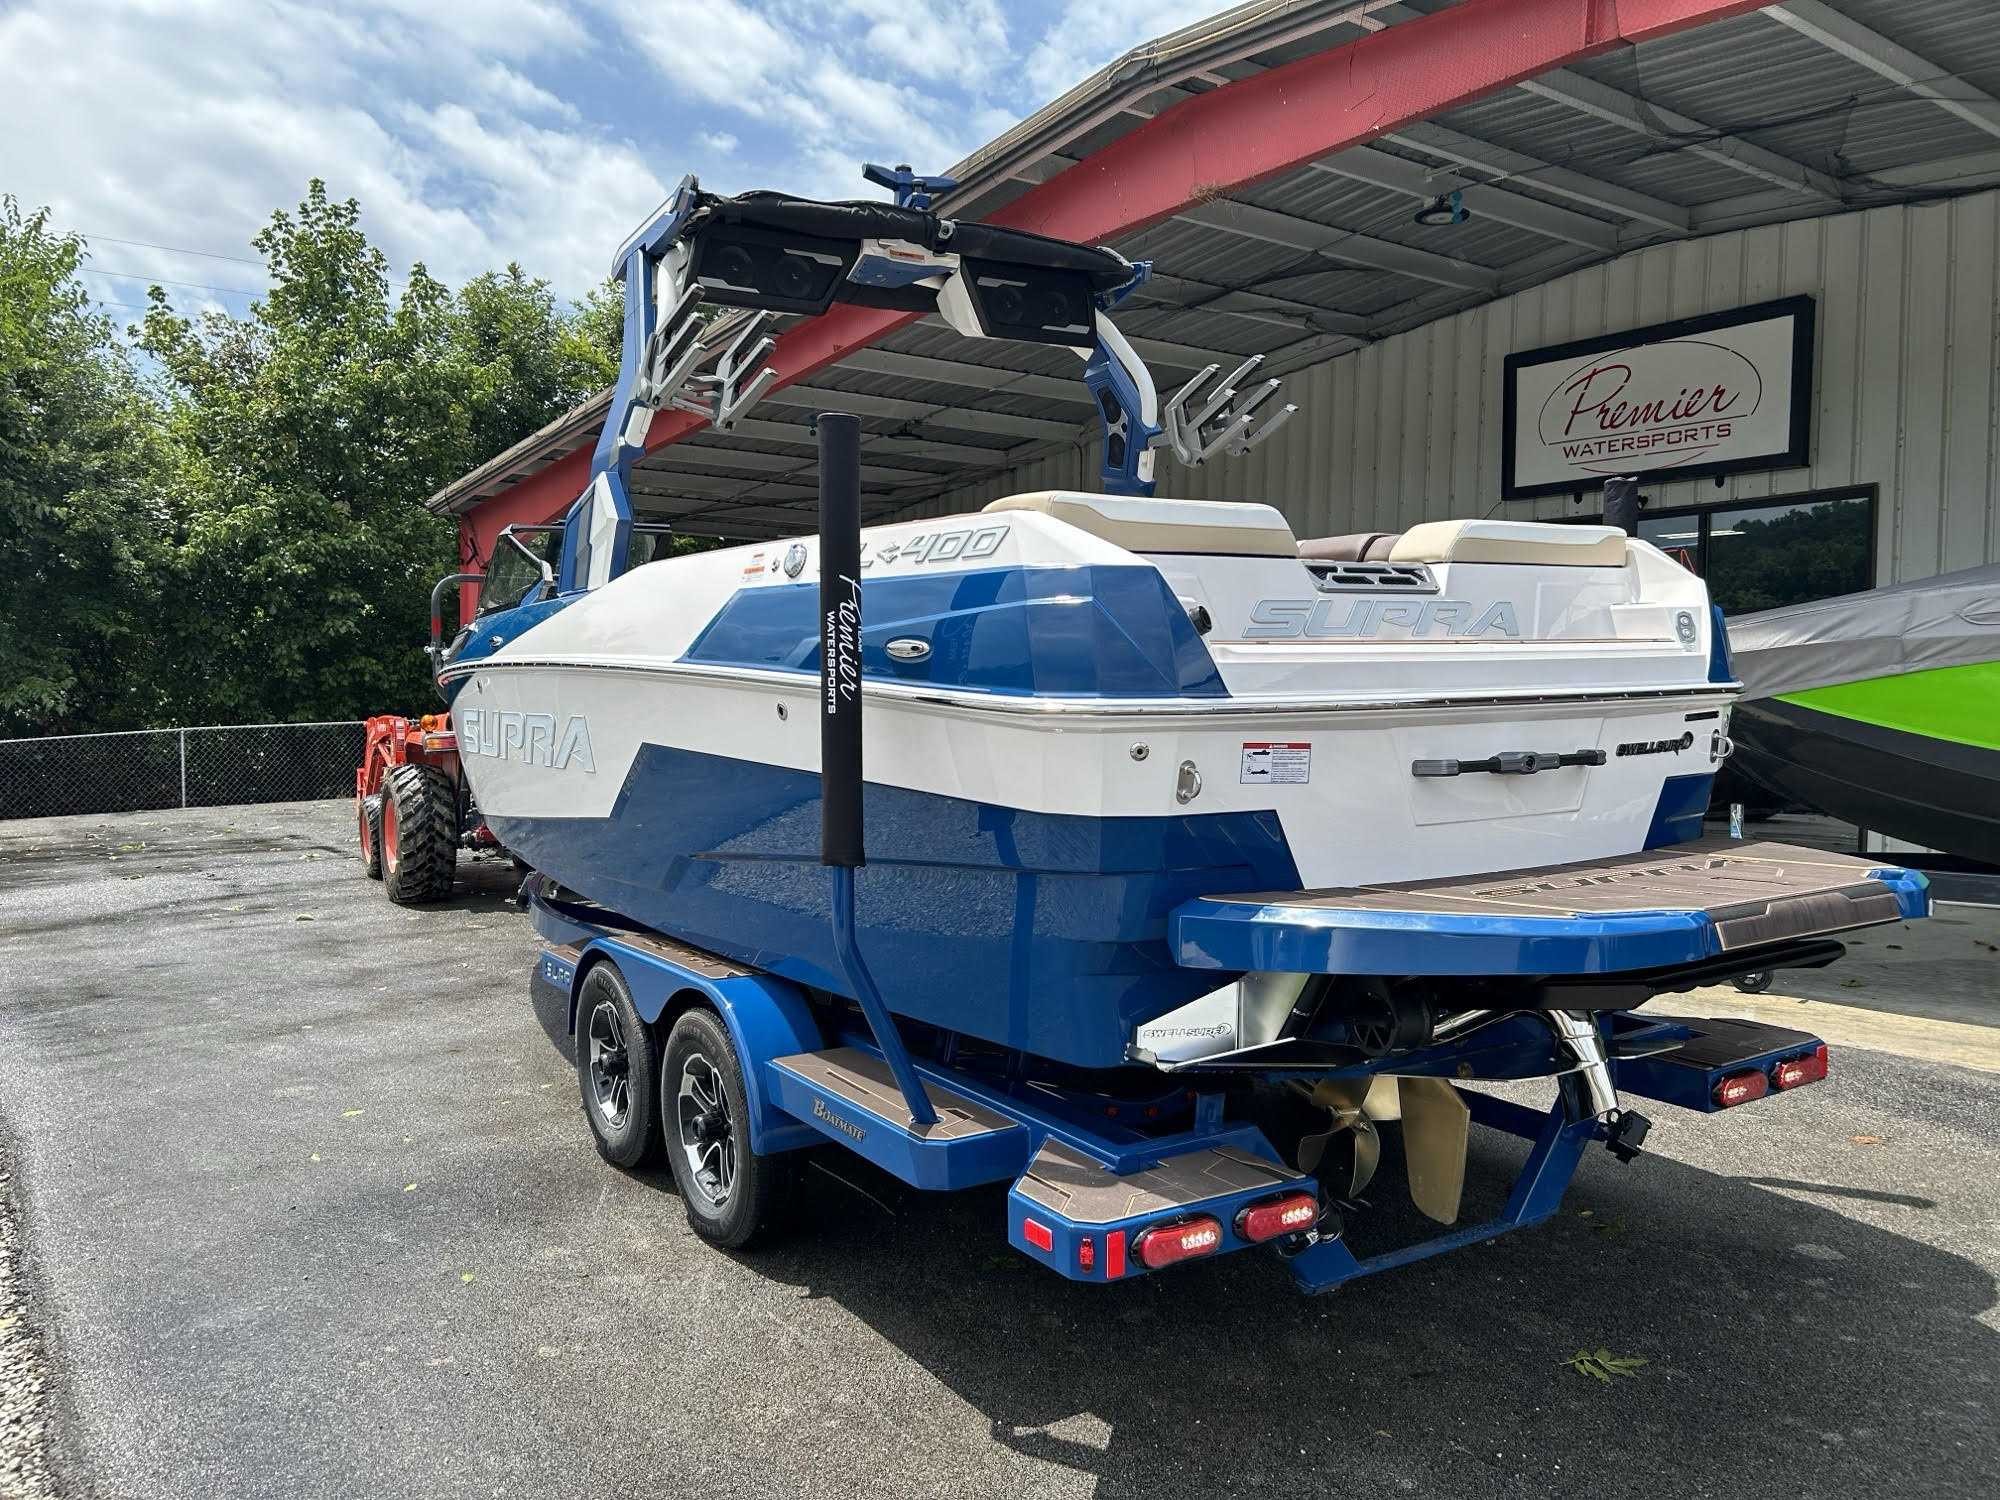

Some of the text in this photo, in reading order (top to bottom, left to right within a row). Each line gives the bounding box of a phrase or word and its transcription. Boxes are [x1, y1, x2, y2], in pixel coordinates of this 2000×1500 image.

[1565, 365, 1740, 436] Premier
[1563, 423, 1731, 459] WATERSPORTS
[900, 526, 1011, 564] 400
[1241, 599, 1520, 640] SUPRA
[826, 610, 836, 714] WATERSPORTS
[462, 707, 597, 774] SUPRA
[1143, 1025, 1225, 1040] SWELLSURF
